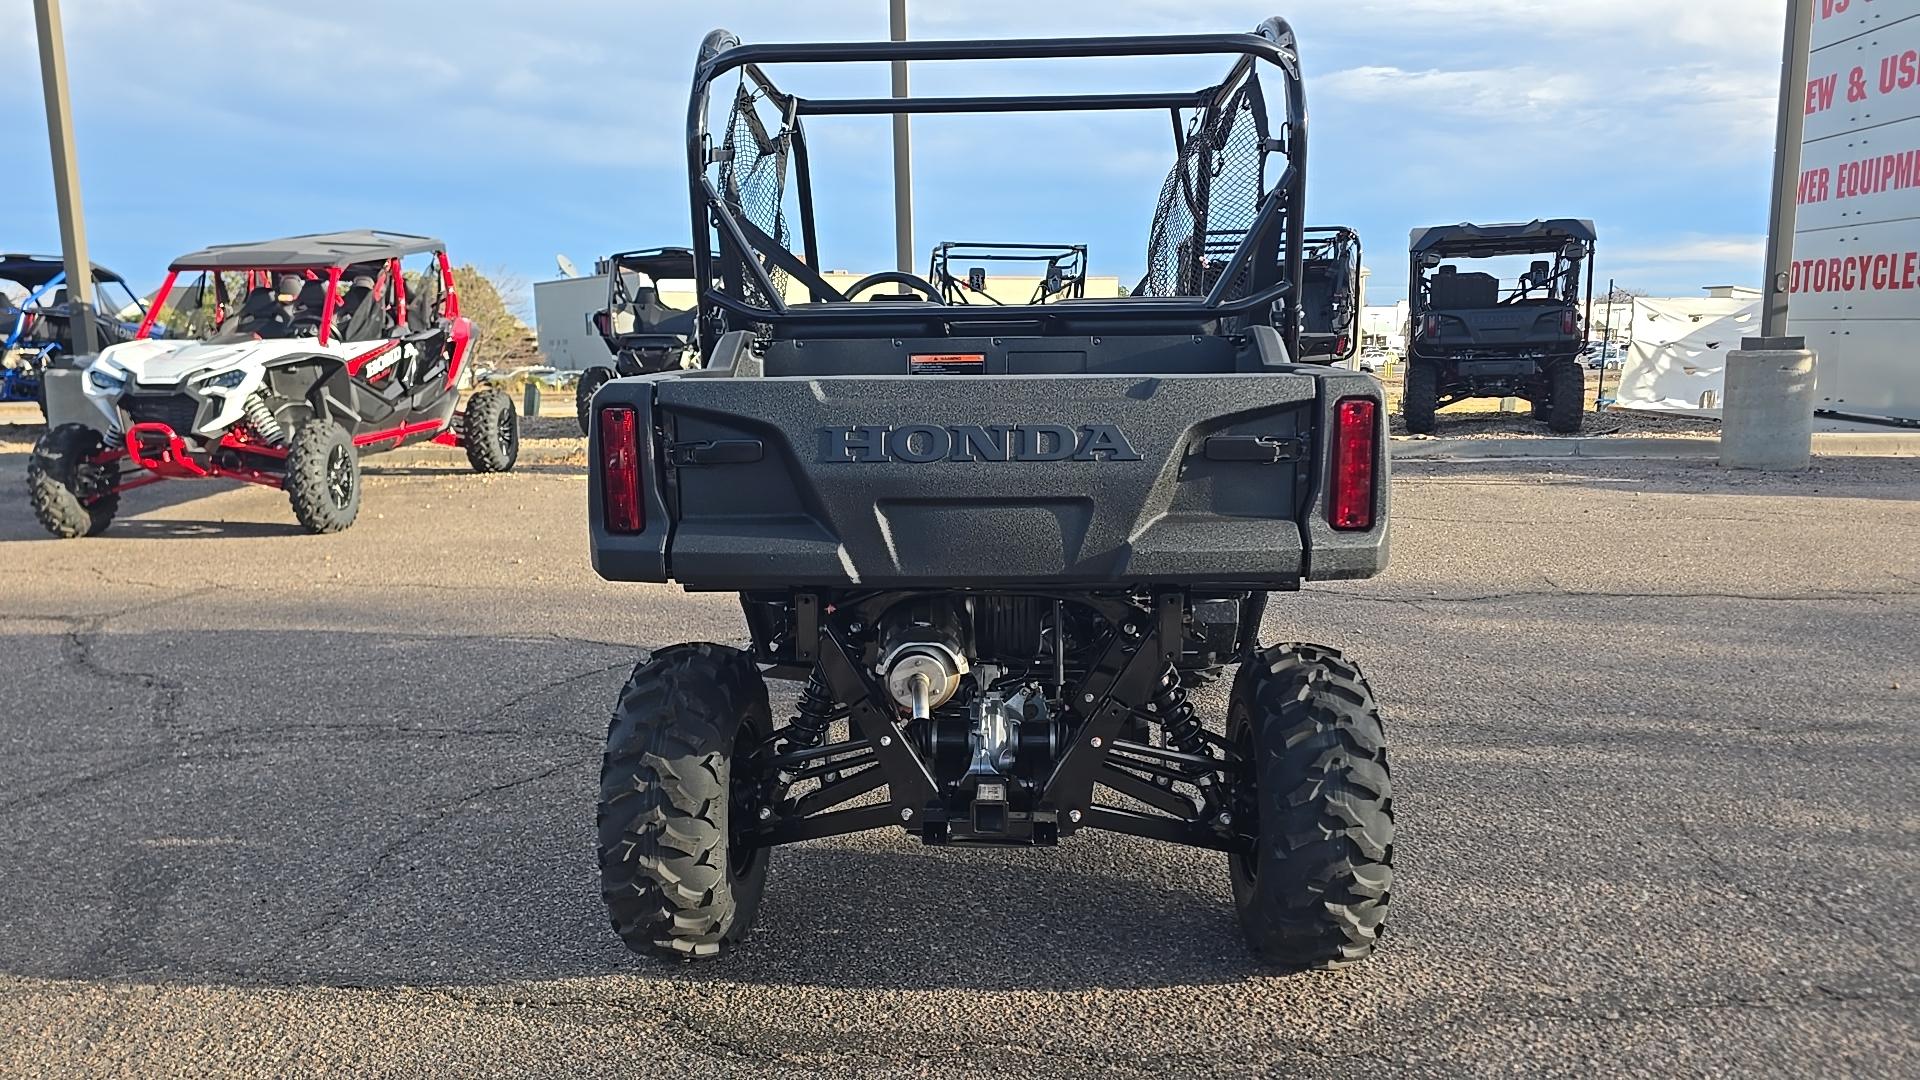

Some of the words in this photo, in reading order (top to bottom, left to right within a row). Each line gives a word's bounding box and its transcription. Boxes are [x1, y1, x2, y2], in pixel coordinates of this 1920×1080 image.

[1805, 72, 1838, 115] EW
[1847, 66, 1867, 103] &
[1879, 50, 1920, 94] US
[1797, 167, 1829, 205] WER
[1790, 251, 1920, 293] OTORCYCLE
[822, 423, 1144, 463] HONDA
